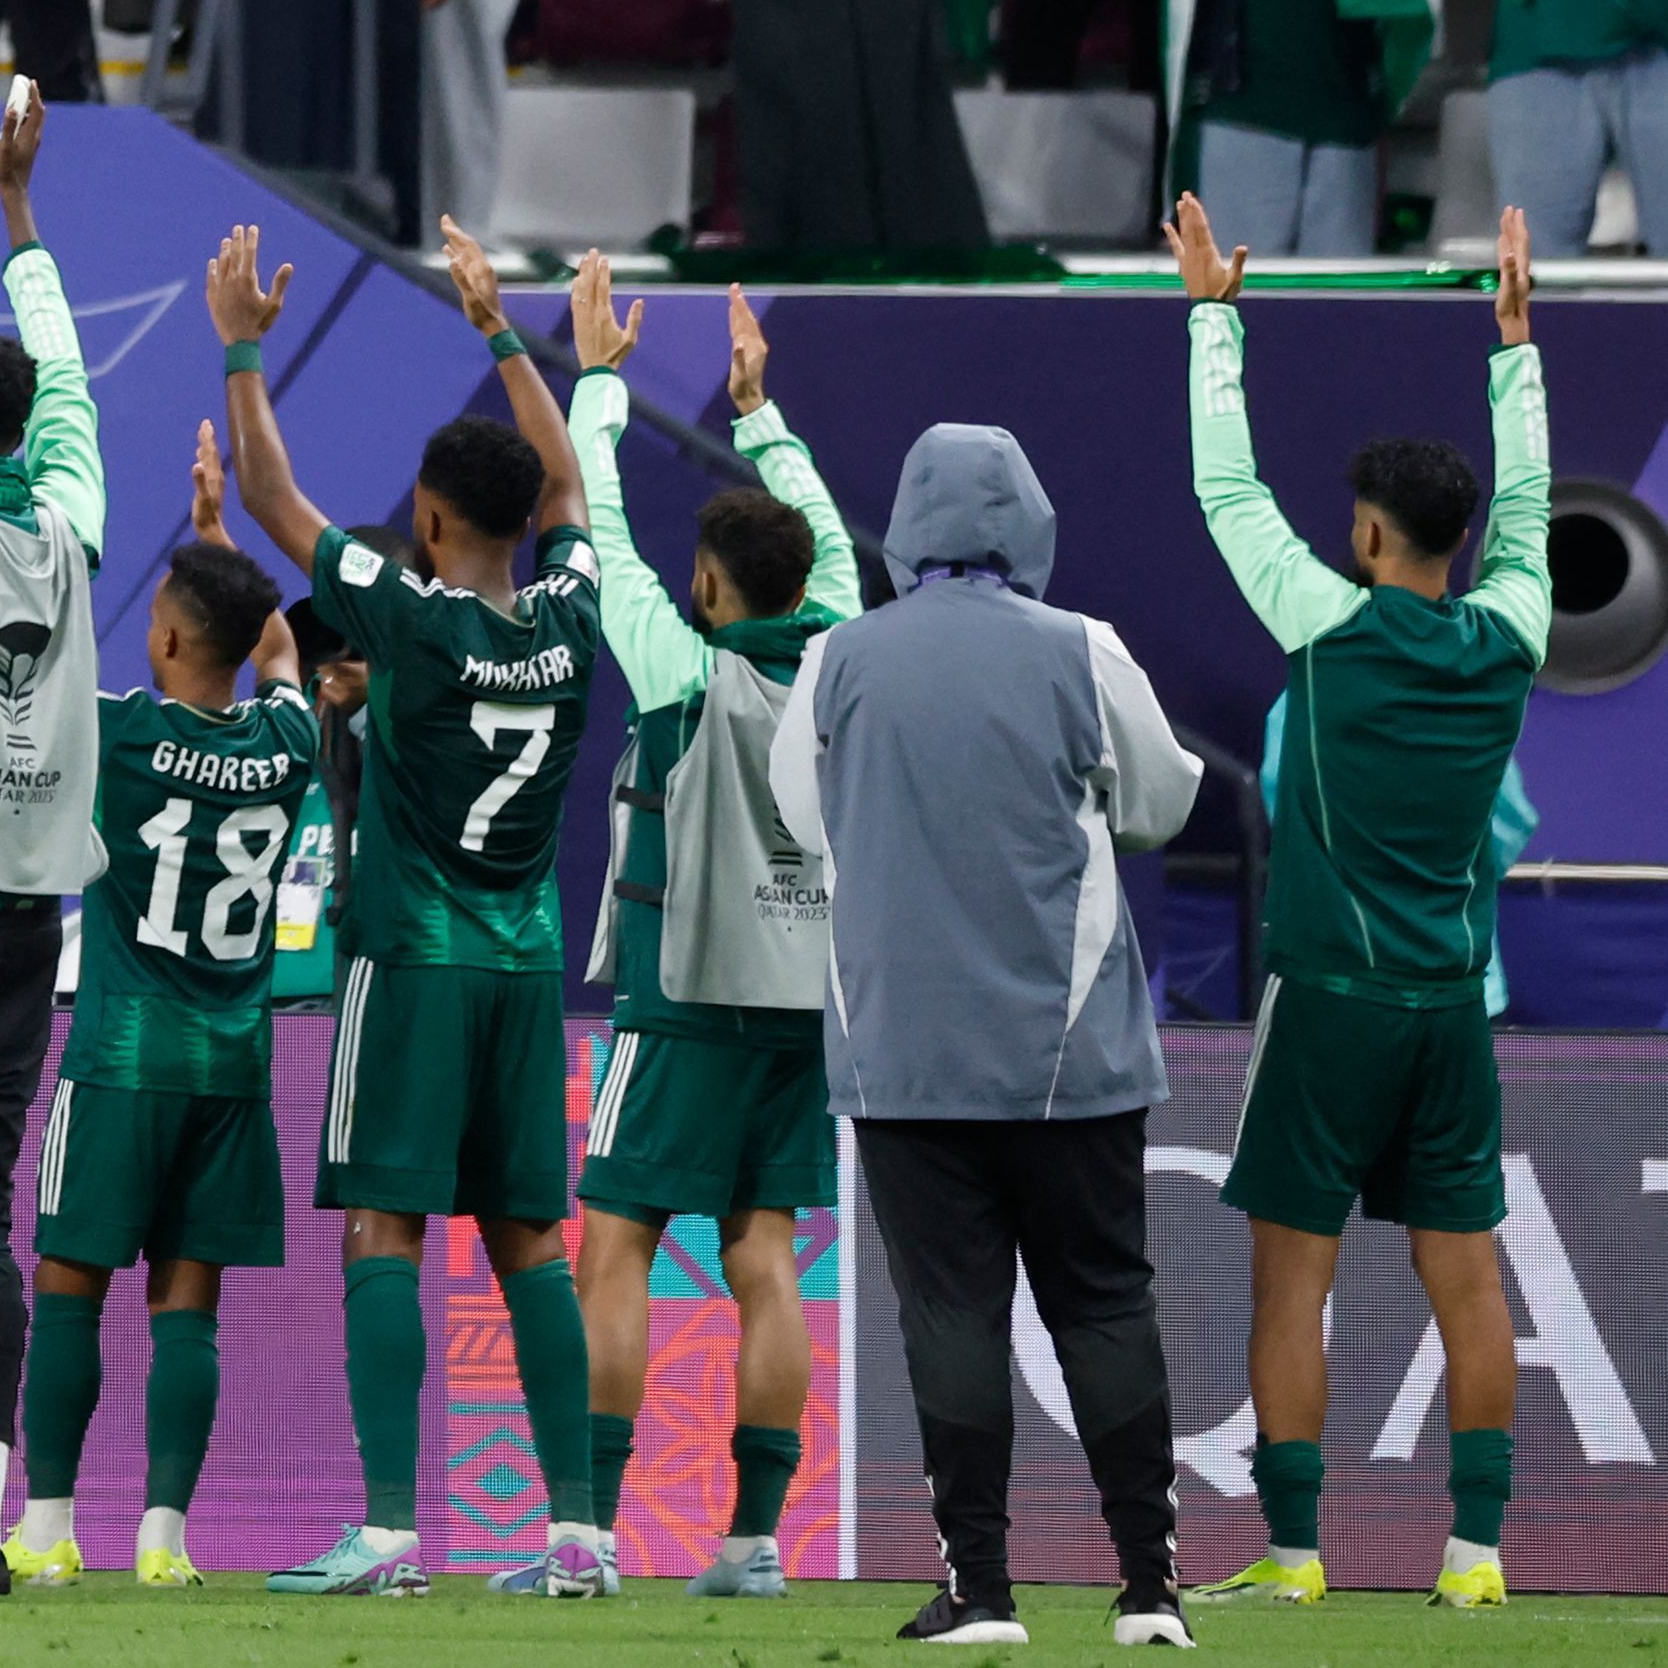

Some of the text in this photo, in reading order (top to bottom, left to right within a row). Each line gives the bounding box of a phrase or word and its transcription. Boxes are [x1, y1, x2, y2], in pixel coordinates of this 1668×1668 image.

[9, 757, 36, 769] AFC
[35, 771, 62, 788] CUP
[152, 740, 290, 792] GHAREEB
[459, 701, 555, 852] 7
[137, 798, 290, 961] 18
[1011, 1147, 1668, 1498] QA
